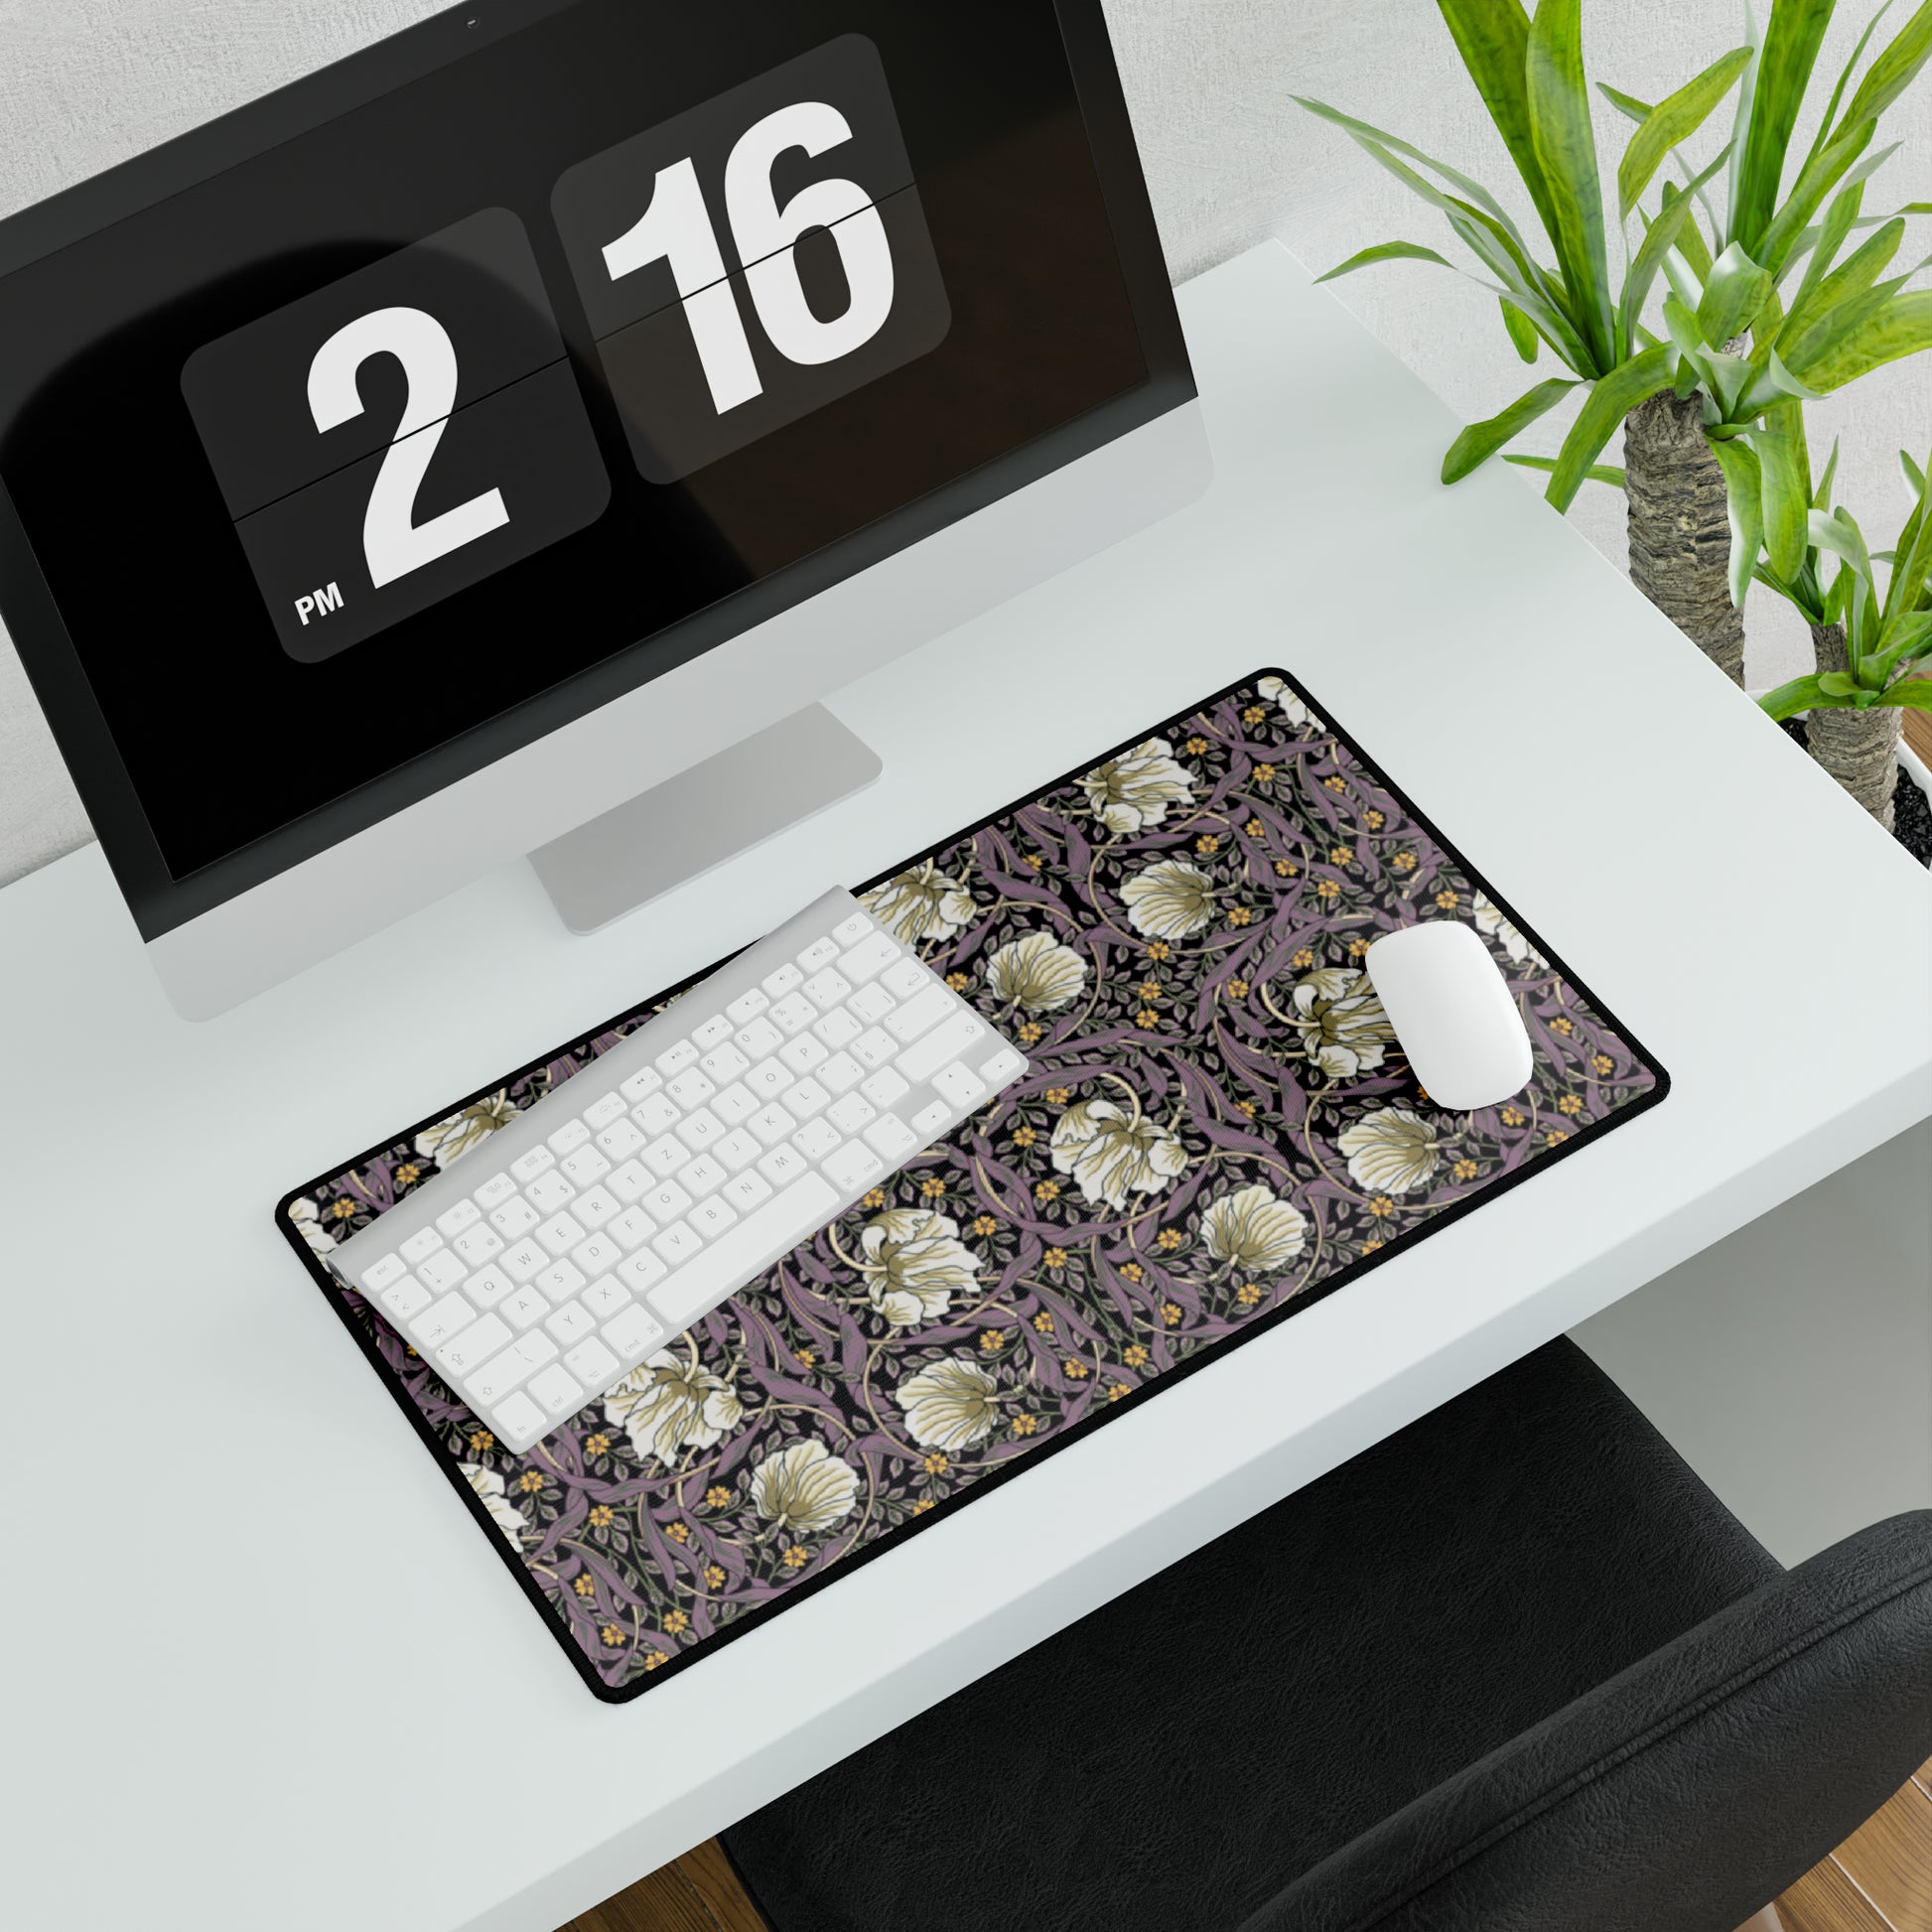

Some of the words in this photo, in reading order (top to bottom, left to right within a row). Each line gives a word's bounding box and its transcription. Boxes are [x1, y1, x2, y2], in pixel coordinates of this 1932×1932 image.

[307, 307, 509, 590] 2
[602, 101, 895, 415] 16
[295, 582, 344, 625] PM
[460, 1239, 471, 1249] 2
[495, 1213, 505, 1223] 3
[533, 1186, 542, 1195] 4
[566, 1160, 577, 1171] 5
[635, 1109, 645, 1119] 7
[671, 1084, 682, 1093] 8
[706, 1058, 715, 1067] 9
[483, 1281, 495, 1291] Q
[516, 1252, 531, 1265] W
[555, 1227, 566, 1238] E
[590, 1201, 603, 1211] R
[625, 1174, 635, 1183] T
[660, 1149, 673, 1160] Z
[695, 1122, 708, 1134] U
[798, 1046, 808, 1057] P
[517, 1300, 529, 1311] A
[553, 1272, 564, 1283] S
[588, 1246, 600, 1257] D
[623, 1219, 632, 1230] F
[659, 1192, 671, 1203] G
[693, 1167, 707, 1177] H
[731, 1141, 740, 1152] J
[763, 1115, 776, 1126] K
[798, 1091, 810, 1100] L
[563, 1313, 573, 1324] Y
[599, 1288, 612, 1300] X
[635, 1261, 647, 1272] C
[669, 1234, 680, 1245] V
[705, 1208, 717, 1219] B
[740, 1181, 753, 1193] N
[774, 1156, 788, 1168] M
[863, 1159, 879, 1172] cmd
[623, 1338, 640, 1352] cmd
